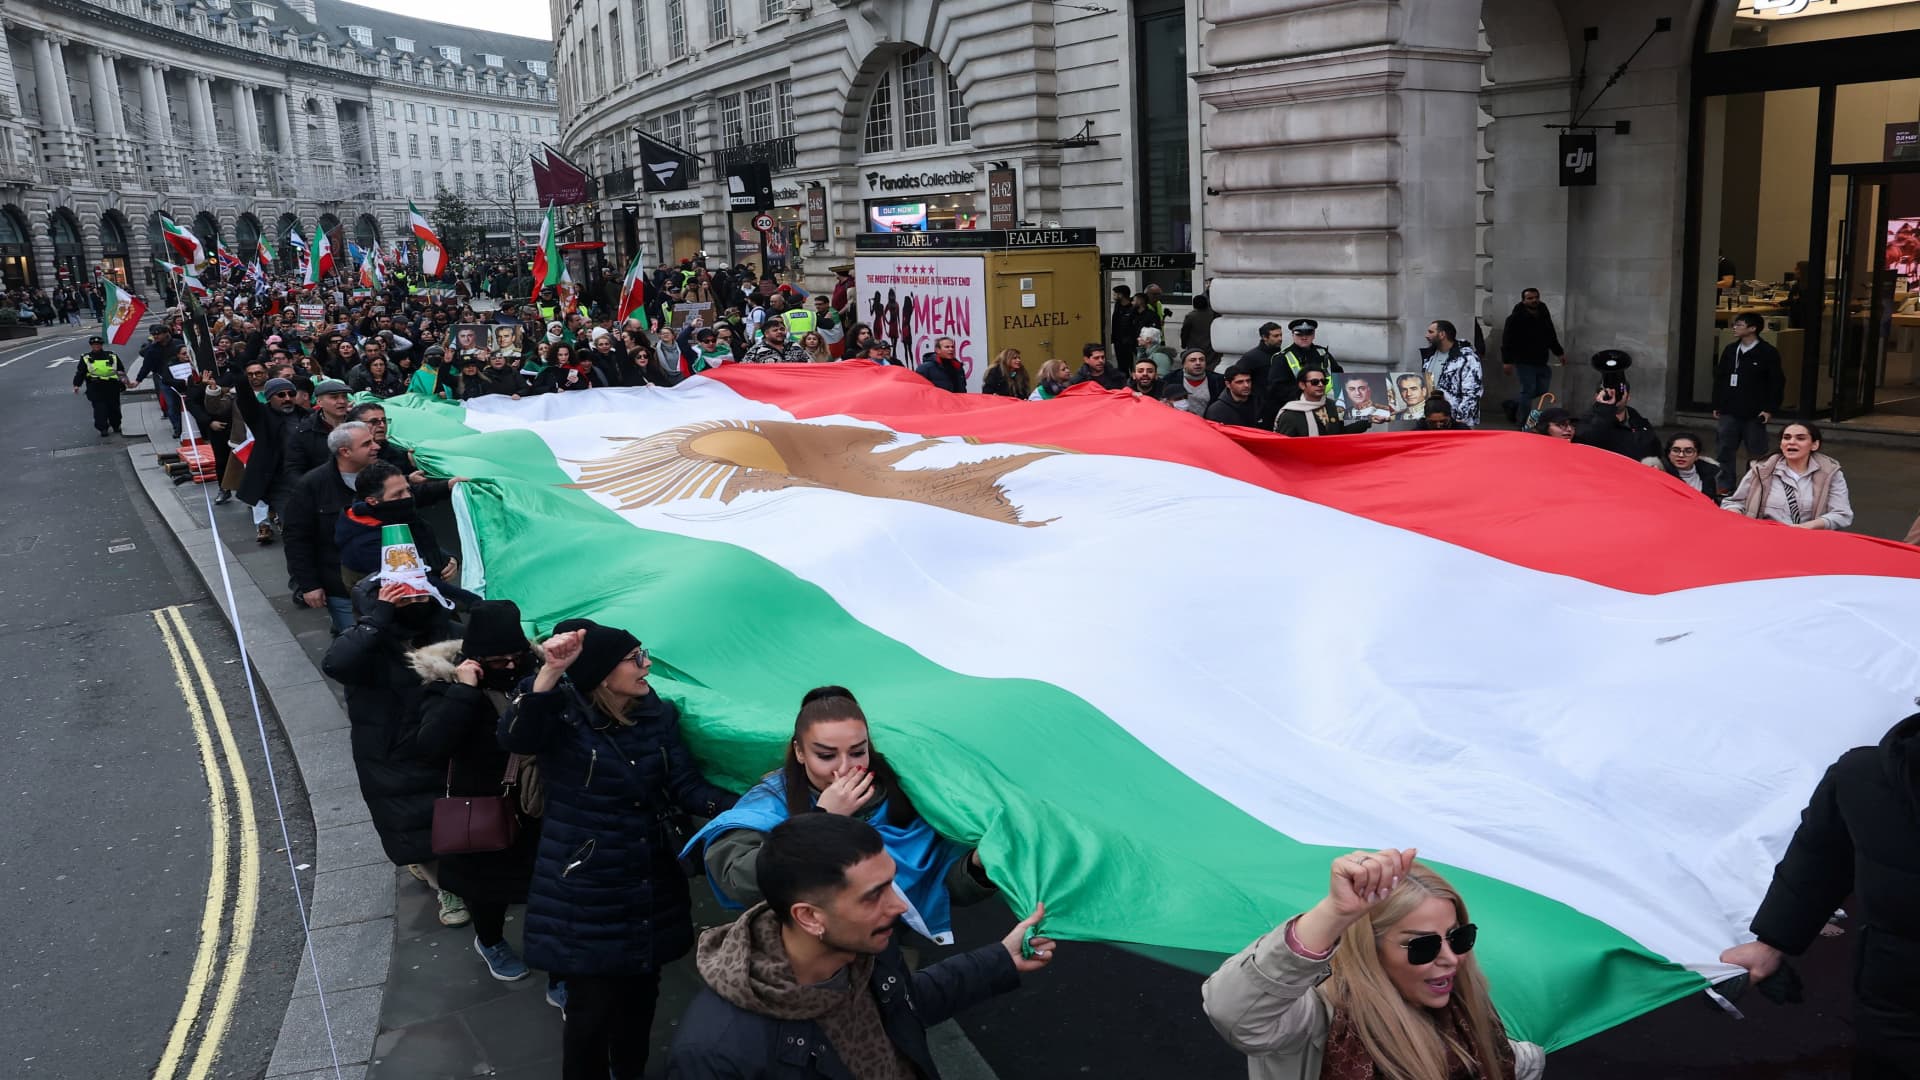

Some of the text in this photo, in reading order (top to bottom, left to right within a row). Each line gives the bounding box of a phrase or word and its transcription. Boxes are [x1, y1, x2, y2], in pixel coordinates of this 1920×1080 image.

[880, 174, 920, 191] Fanatics
[882, 207, 896, 215] OUT
[896, 234, 932, 247] FALAFEL
[1009, 231, 1068, 245] FALAFEL
[1111, 255, 1164, 268] FALAFEL
[867, 275, 875, 283] THE
[875, 275, 890, 284] MOST
[890, 275, 900, 284] FUN
[901, 275, 910, 284] YOU
[910, 276, 918, 285] CAN
[919, 276, 930, 285] HAVE
[943, 277, 958, 286] WEST
[958, 277, 971, 286] END
[914, 294, 970, 337] MEAN
[1003, 312, 1069, 329] FALAFEL
